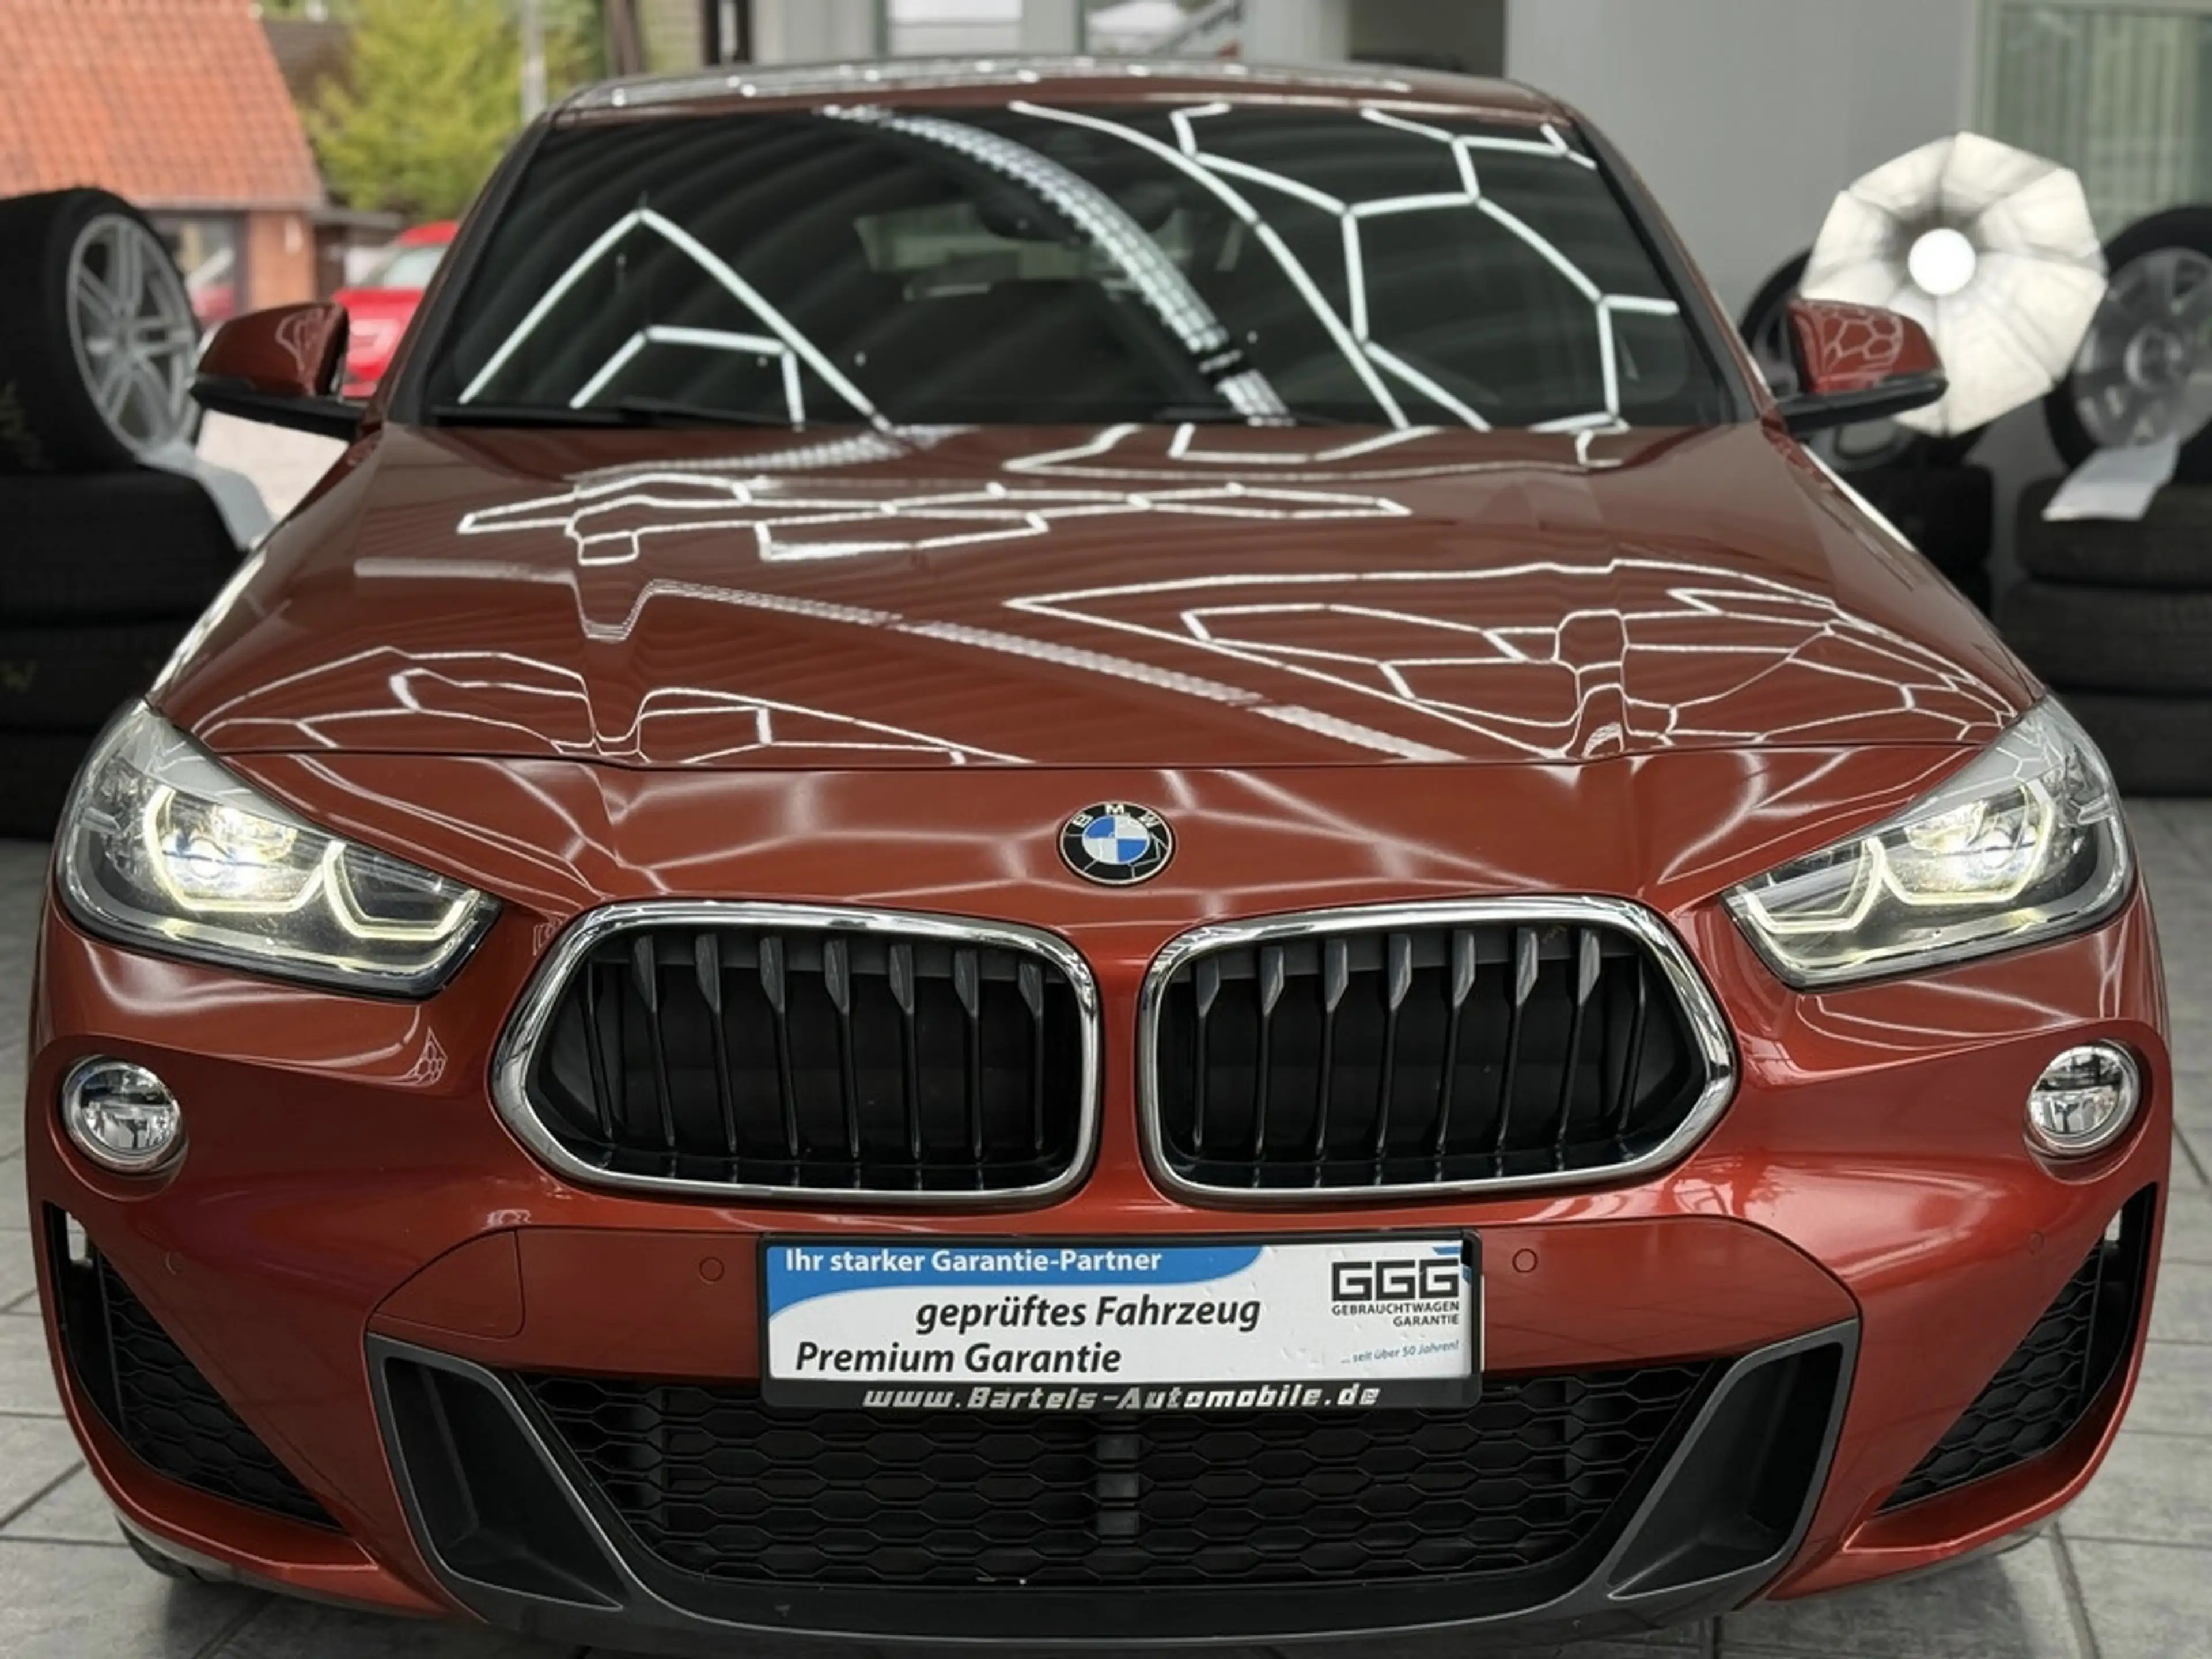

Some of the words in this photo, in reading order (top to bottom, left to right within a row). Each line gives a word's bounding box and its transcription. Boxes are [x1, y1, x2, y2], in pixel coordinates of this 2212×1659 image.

[1071, 804, 1160, 828] BMW
[786, 1249, 823, 1271] Ihr
[830, 1249, 925, 1271] starker
[931, 1249, 1162, 1272] Garantie-Partner
[1332, 1258, 1459, 1301] GGG
[916, 1294, 1086, 1336] geprüftes
[1096, 1294, 1260, 1332] Fahrzeug
[1331, 1301, 1459, 1316] GEBRAUCHTWAGEN
[1393, 1314, 1459, 1327] GARANTIE
[796, 1341, 954, 1373] Premium
[965, 1341, 1122, 1373] Garantie
[863, 1383, 1381, 1409] www.Bartels-Automobile.de
